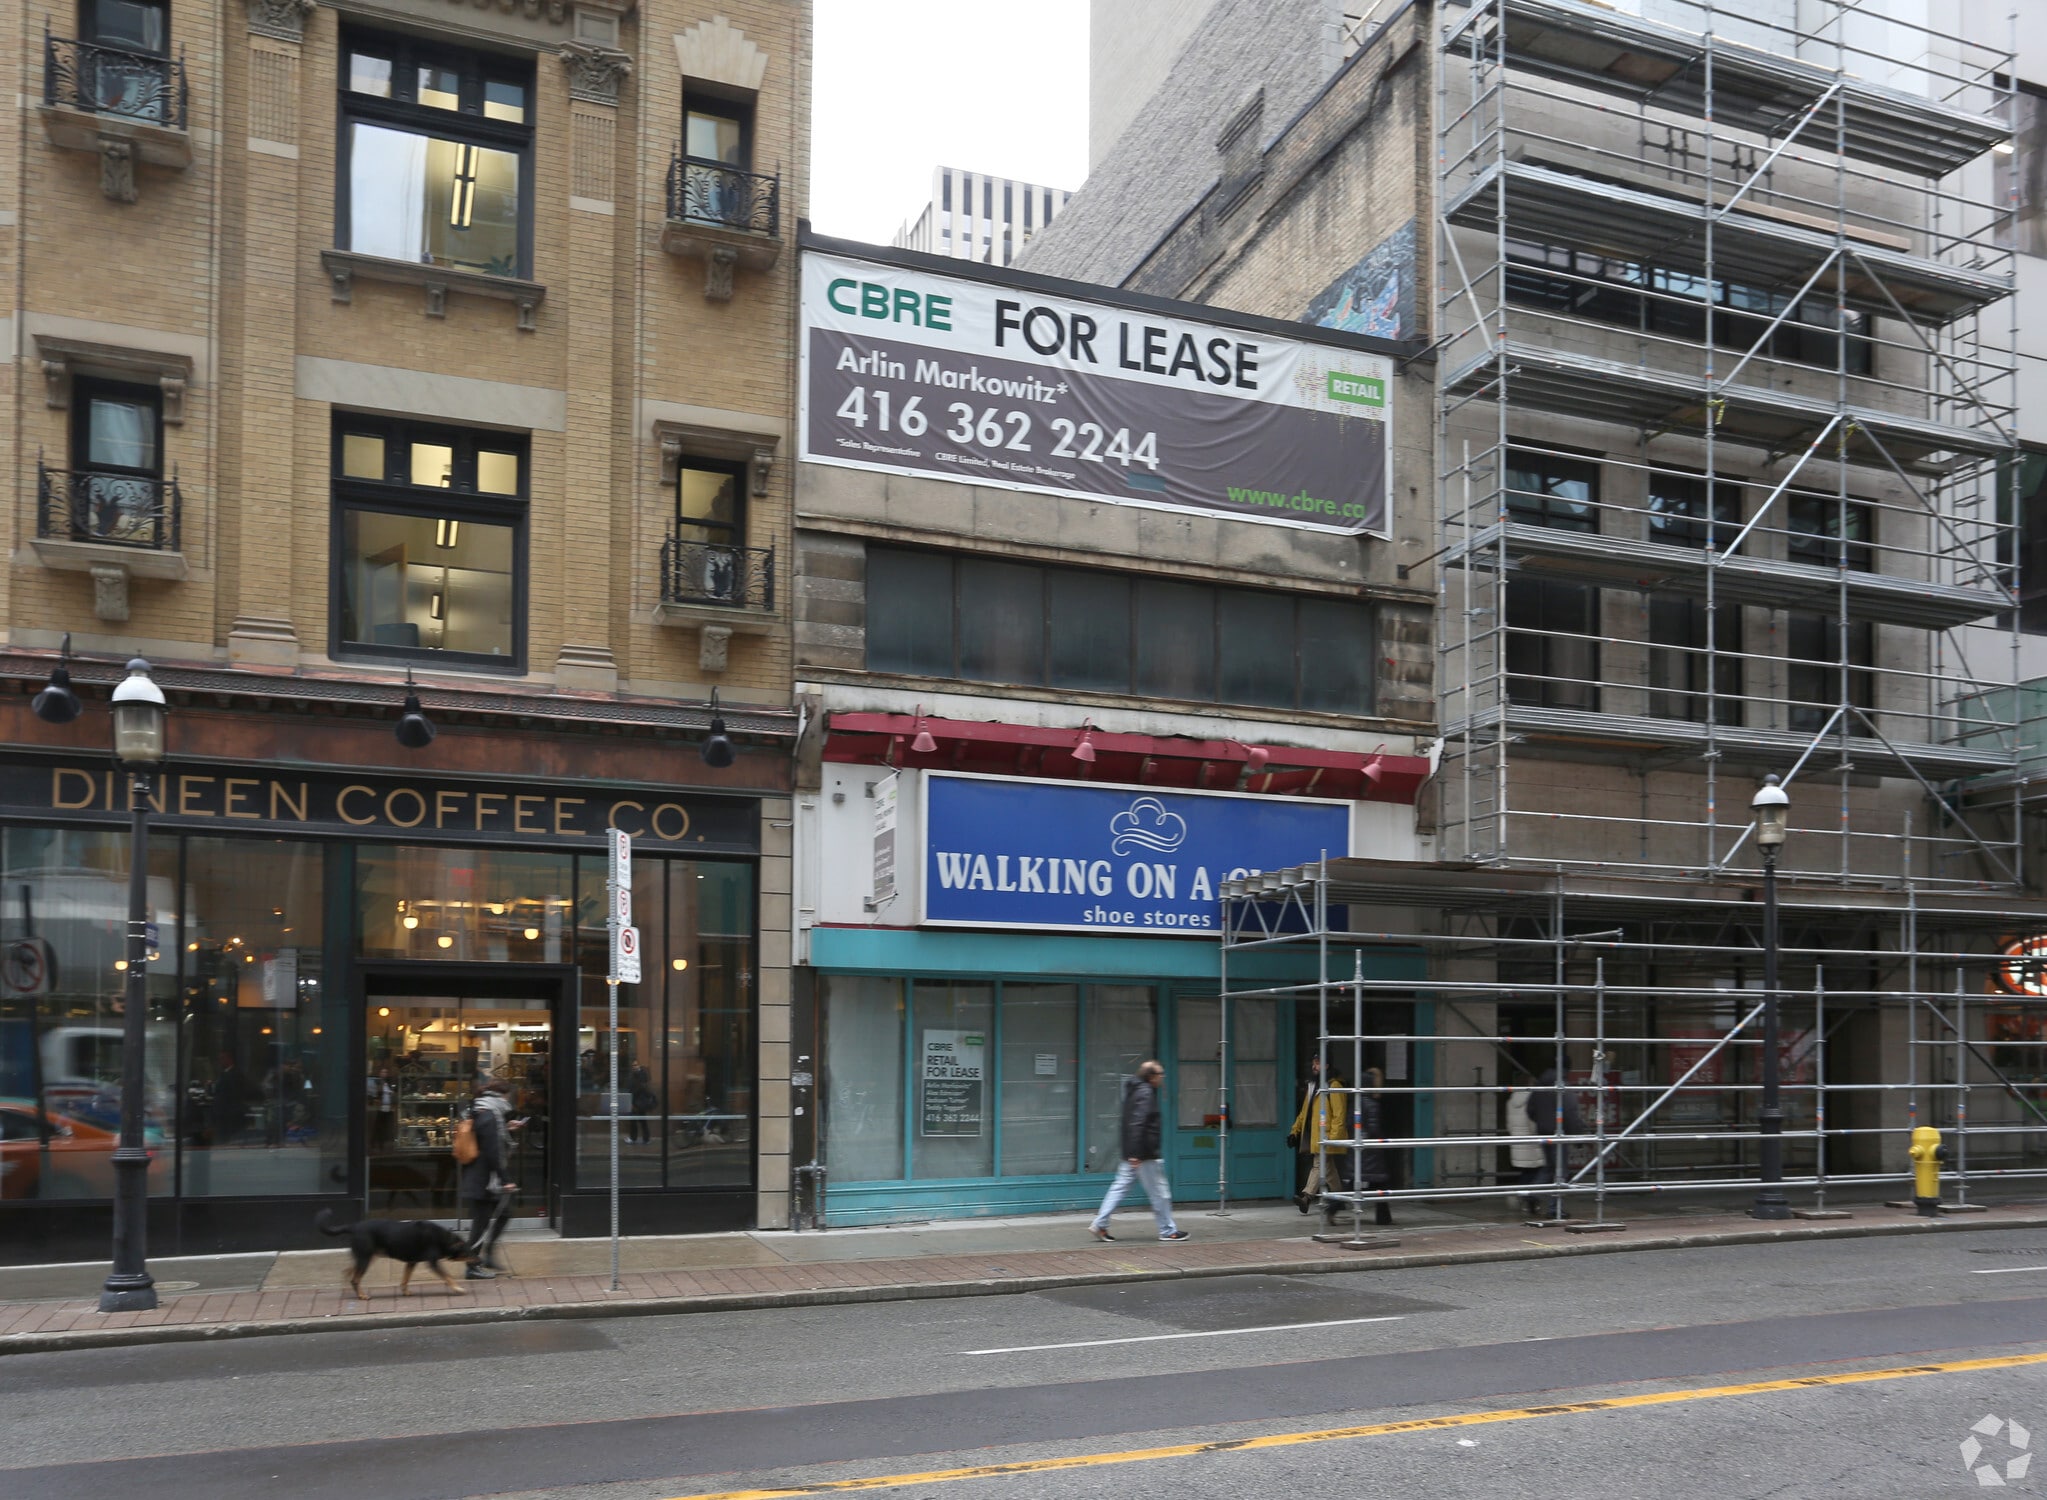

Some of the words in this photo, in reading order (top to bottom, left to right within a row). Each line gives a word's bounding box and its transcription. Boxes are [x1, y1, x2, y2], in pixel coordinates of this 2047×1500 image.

[827, 278, 953, 332] CBRE
[995, 299, 1098, 364] FOR
[1119, 321, 1258, 390] LEASE
[836, 346, 906, 380] Arlin
[1332, 379, 1381, 400] RETAIL
[836, 386, 928, 437] 416
[946, 401, 1032, 452] 362
[1049, 417, 1160, 471] 2244
[862, 441, 922, 458] Representative
[991, 459, 1010, 470] Real
[1010, 462, 1035, 473] Estate
[1035, 465, 1077, 480] Brokerage
[1226, 486, 1367, 519] www.cbre.ca
[53, 767, 308, 821] DINEEN
[336, 785, 586, 836] COFFEE
[608, 800, 705, 842] CO.
[936, 852, 1112, 897] WALKING
[1126, 862, 1177, 899] ON
[1189, 866, 1214, 901] A
[1083, 905, 1135, 924] shoe
[1143, 909, 1212, 927] stores
[927, 1042, 953, 1052] CBRE
[926, 1055, 959, 1066] RETAIL
[926, 1066, 948, 1078] FOR
[951, 1067, 980, 1078] LEASE
[925, 1113, 942, 1122] 416
[943, 1113, 958, 1122] 362
